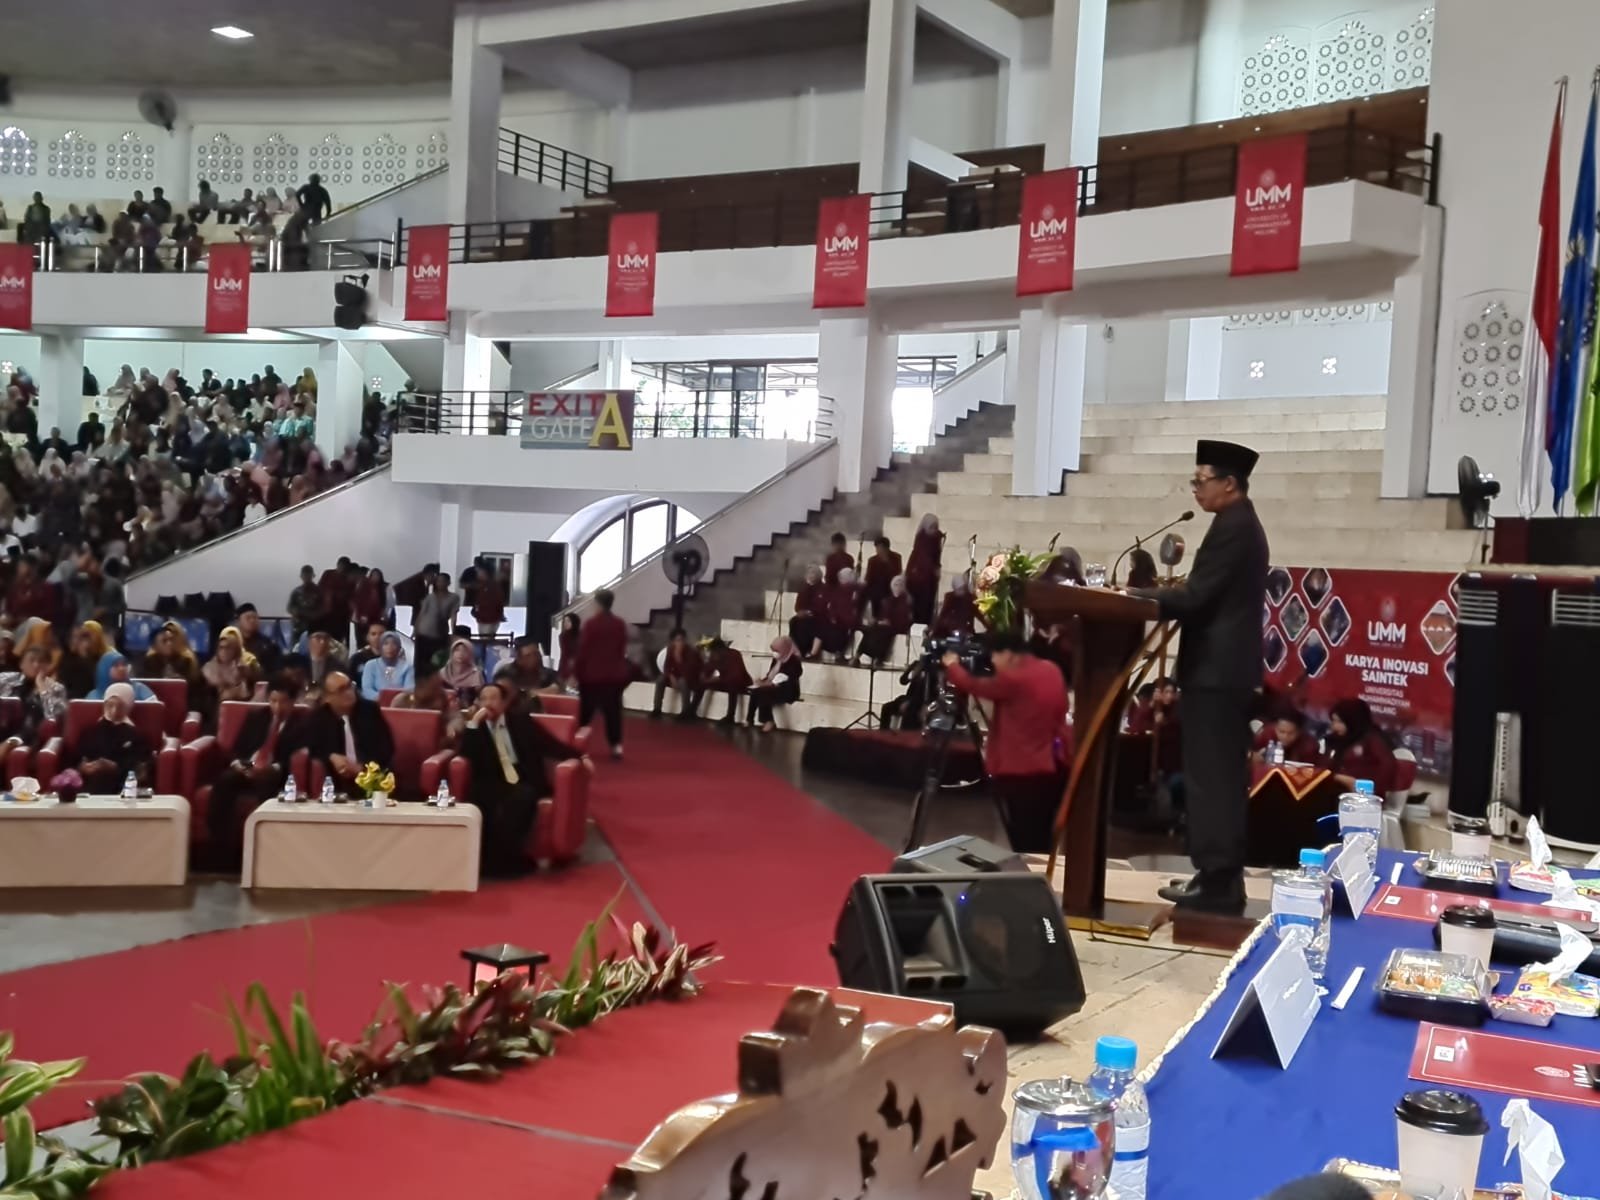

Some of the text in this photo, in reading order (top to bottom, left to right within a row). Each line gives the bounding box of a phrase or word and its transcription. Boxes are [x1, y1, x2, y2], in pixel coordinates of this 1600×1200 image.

[1245, 182, 1292, 207] UMM
[1029, 217, 1068, 238] UMM
[824, 235, 859, 253] UMM
[413, 264, 441, 278] UMM
[617, 254, 649, 268] UMM
[214, 277, 242, 291] UMM
[528, 392, 606, 416] EXIT
[531, 416, 595, 440] GATE
[588, 392, 631, 448] A
[1368, 620, 1407, 643] UMM
[1345, 653, 1429, 675] KARYA INOVASI
[1362, 669, 1408, 687] SAINTEK
